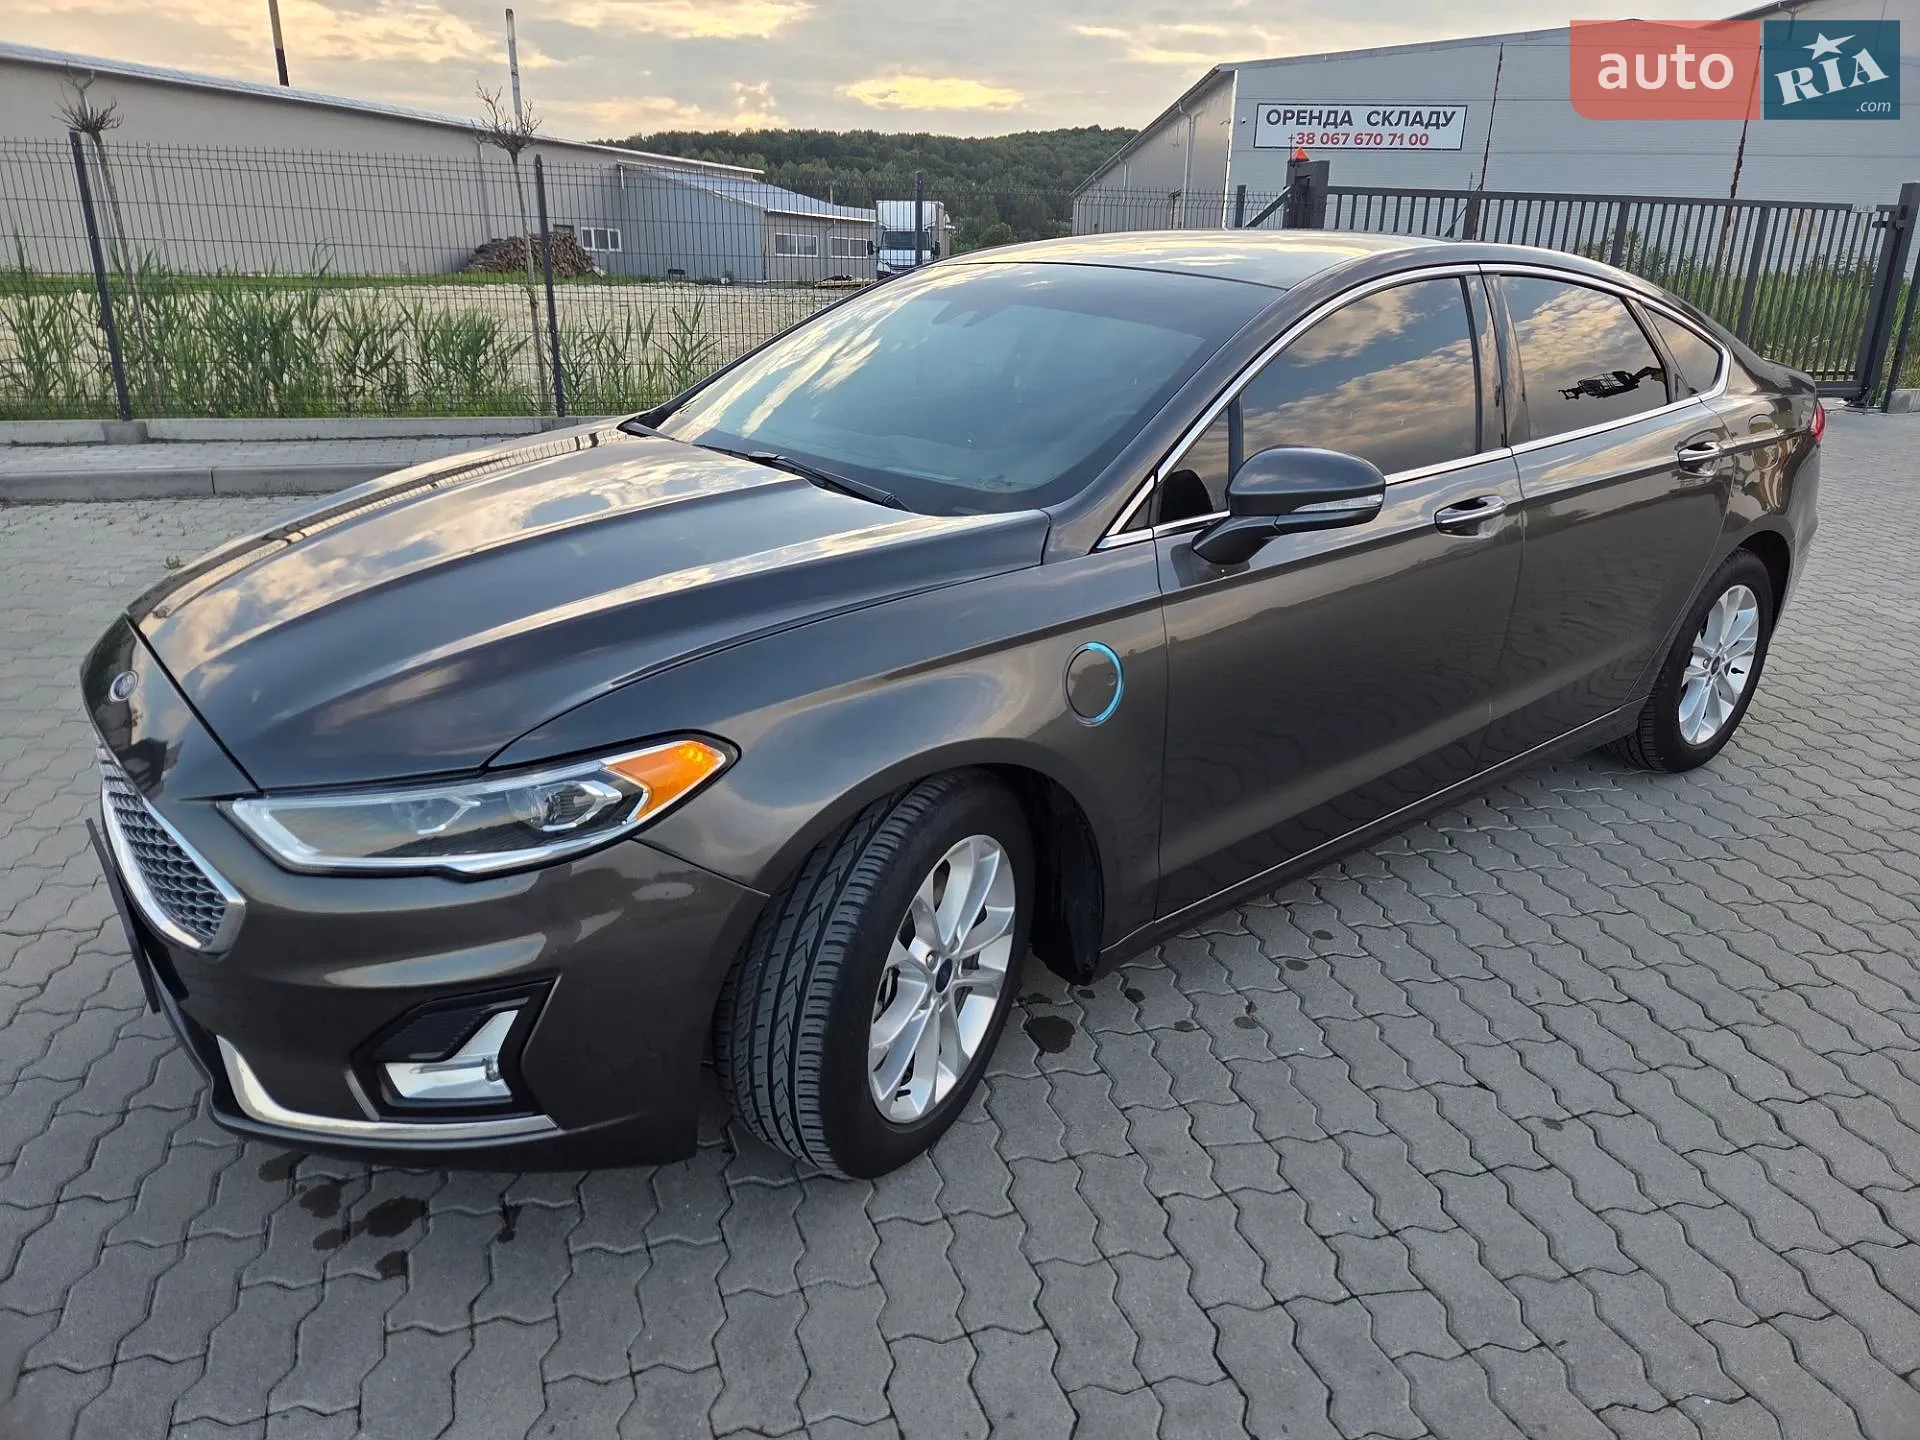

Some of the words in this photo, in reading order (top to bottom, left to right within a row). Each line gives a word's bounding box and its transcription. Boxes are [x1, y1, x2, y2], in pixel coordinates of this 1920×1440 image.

[1265, 109, 1353, 128] ОРЕНДА
[1366, 110, 1456, 129] СКЛАДУ
[1287, 132, 1315, 145] +38
[1320, 133, 1350, 145] 067
[1354, 133, 1383, 146] 670
[1388, 133, 1404, 146] 71
[1408, 133, 1429, 146] 00
